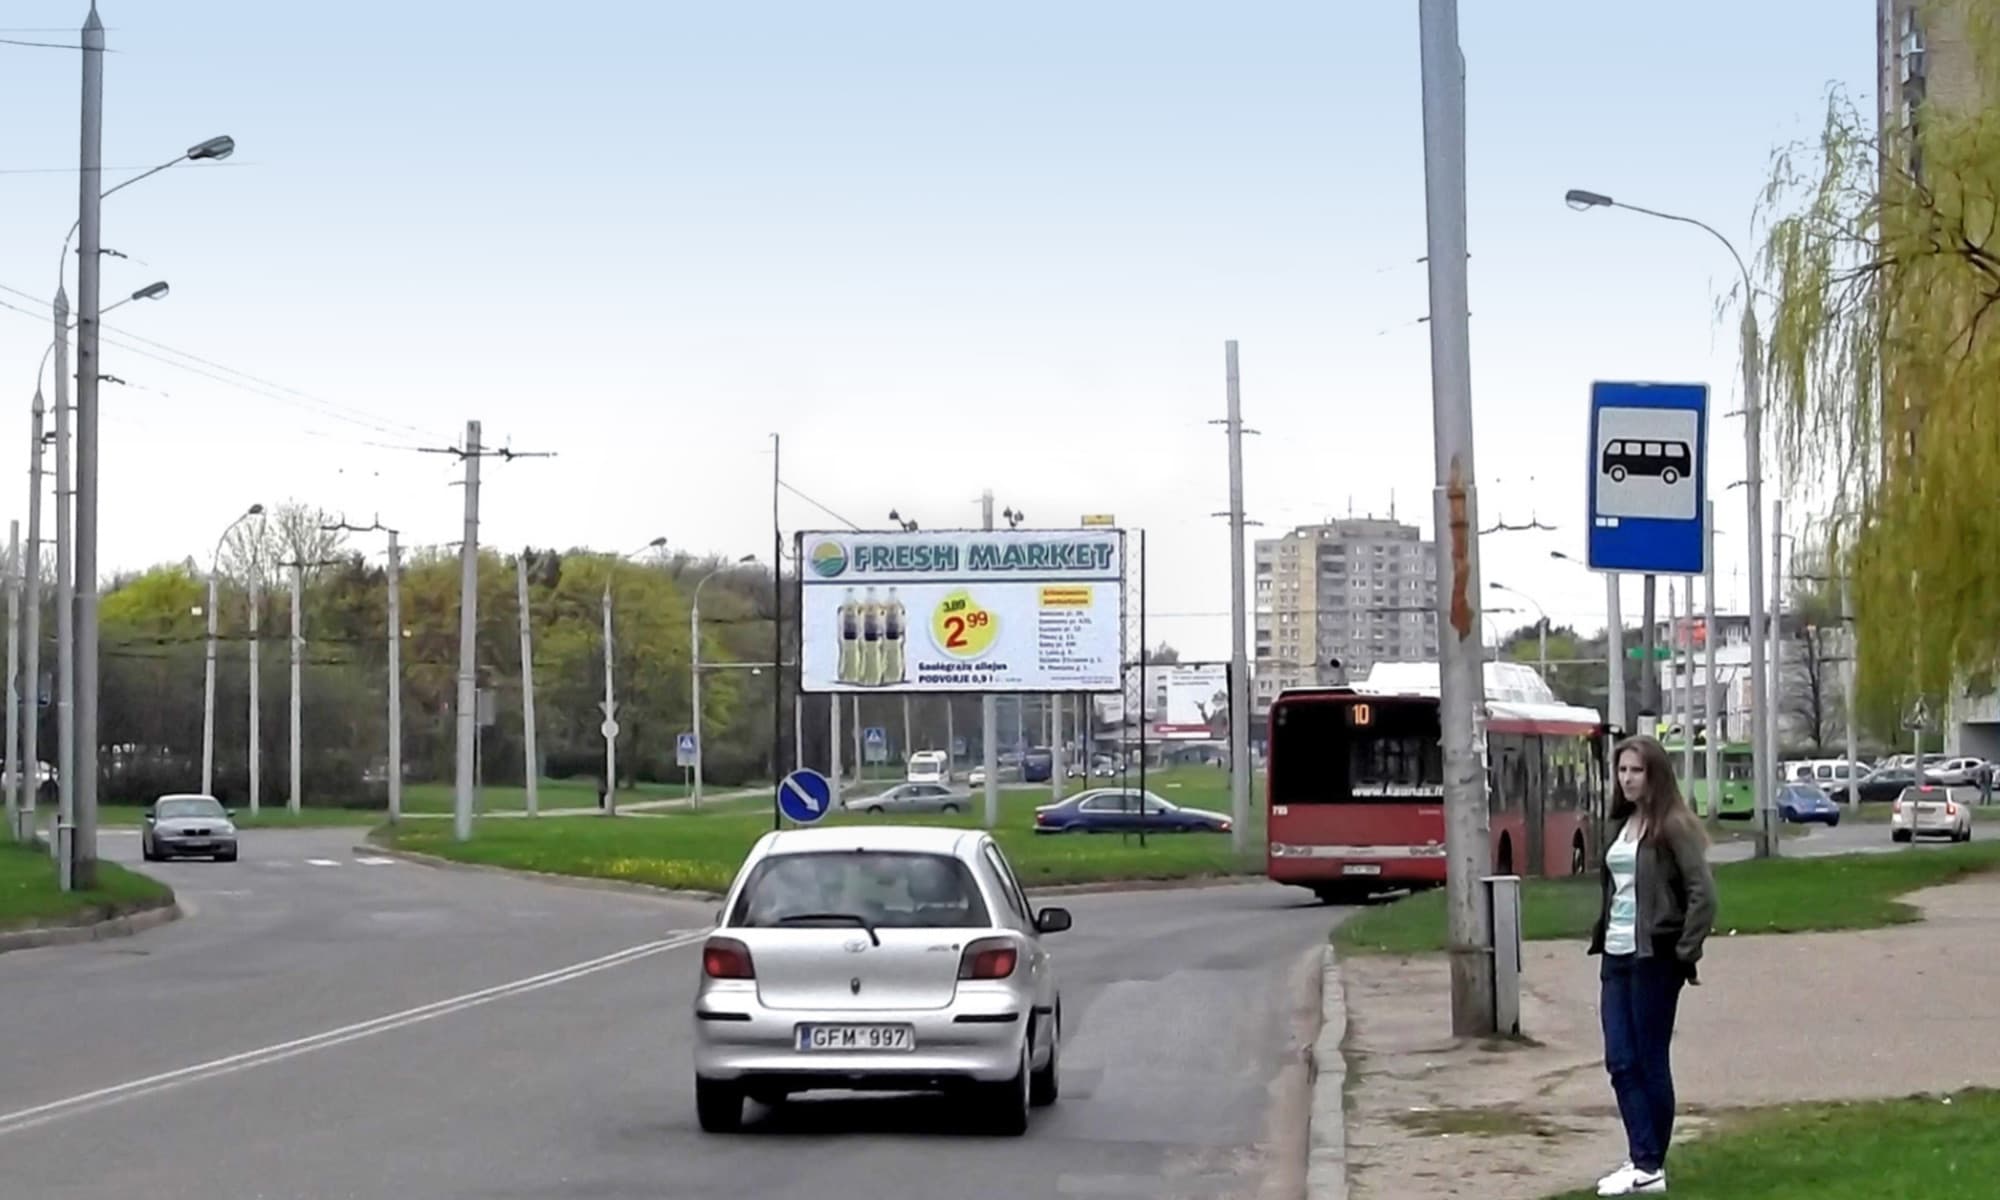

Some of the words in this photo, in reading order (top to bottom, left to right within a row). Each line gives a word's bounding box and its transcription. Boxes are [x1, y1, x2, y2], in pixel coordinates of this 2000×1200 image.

[854, 545, 959, 571] FRESH
[968, 542, 1113, 571] MARKET
[1352, 703, 1370, 725] 10
[814, 1028, 856, 1047] GFM
[869, 1028, 905, 1047] 997
